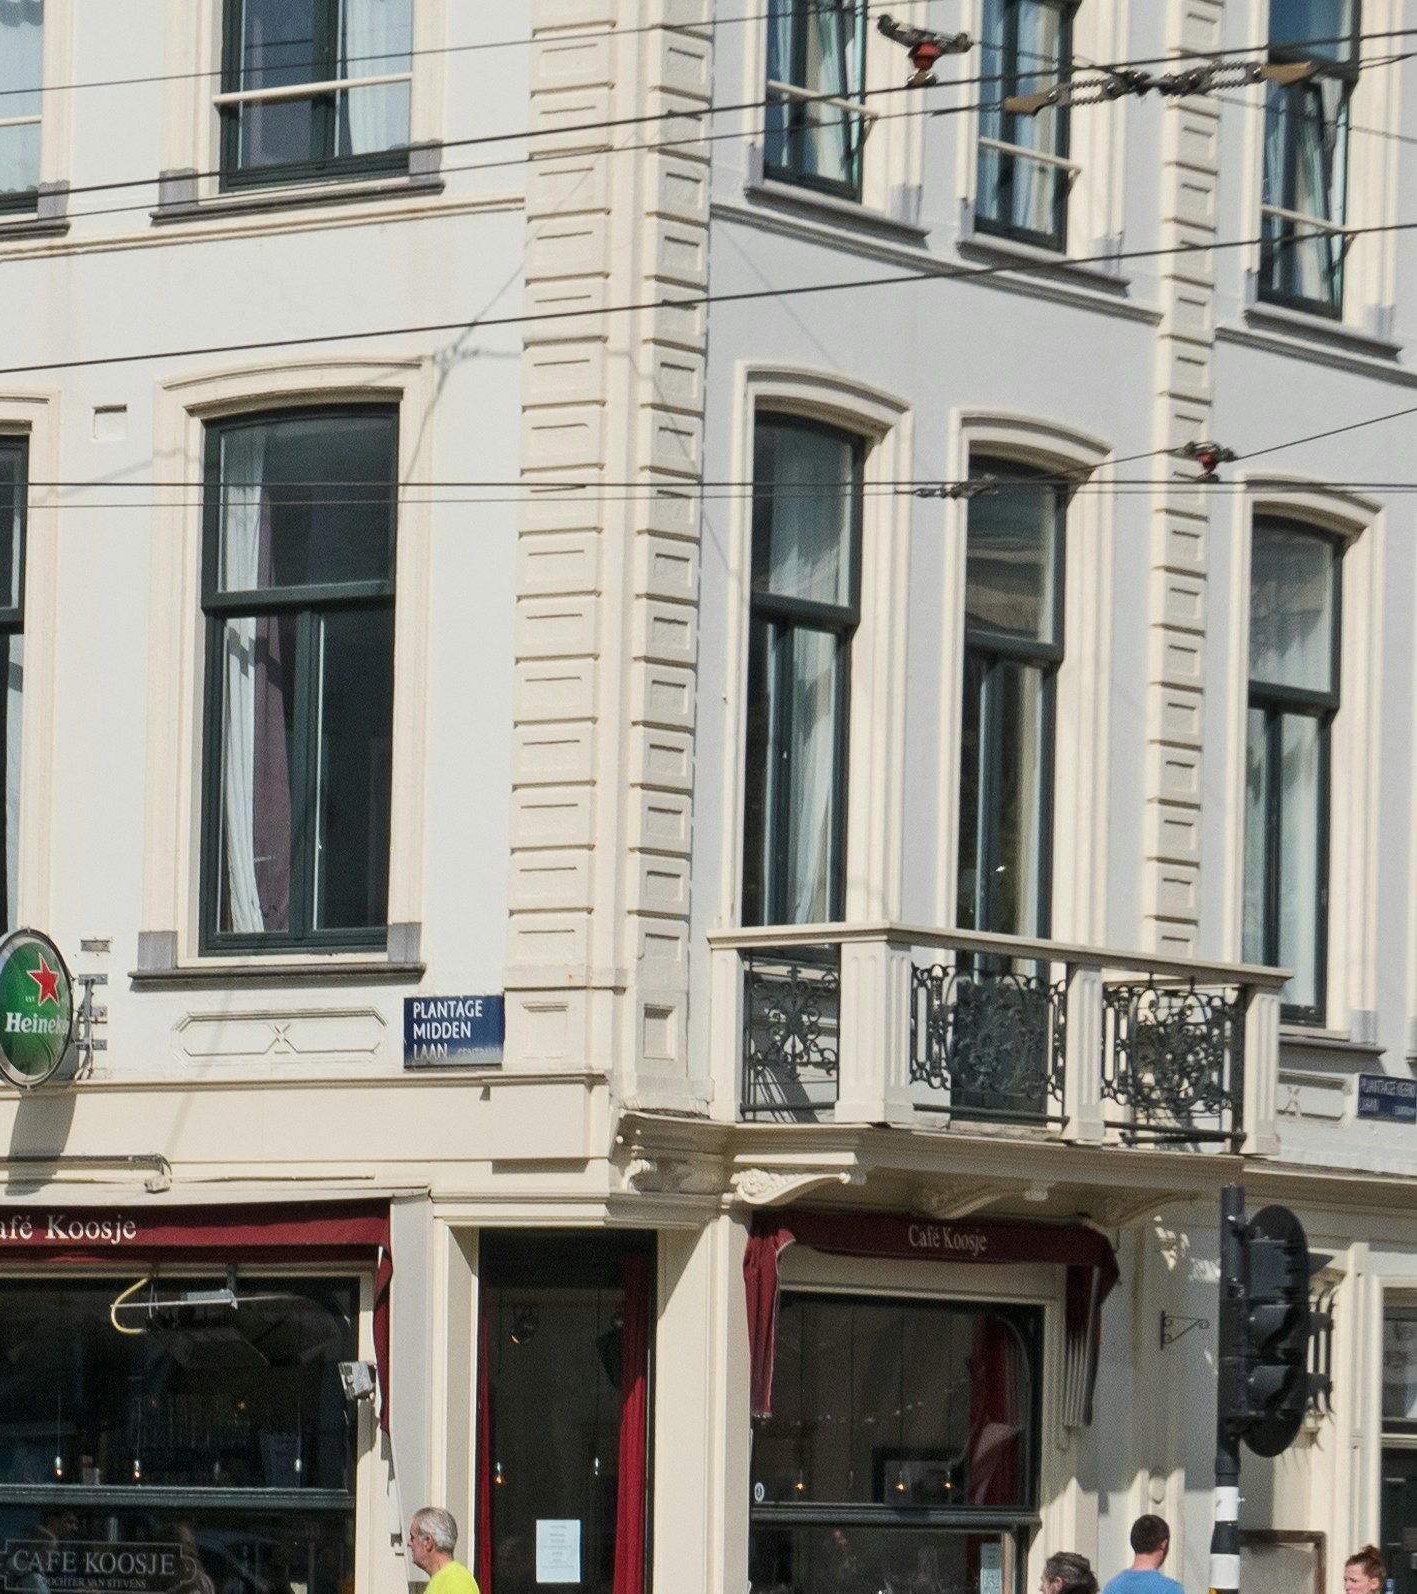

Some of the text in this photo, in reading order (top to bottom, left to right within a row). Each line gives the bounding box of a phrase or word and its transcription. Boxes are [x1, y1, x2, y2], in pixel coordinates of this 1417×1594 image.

[413, 1000, 483, 1019] PLANTAGE
[413, 1021, 471, 1040] MIDDEN
[413, 1042, 448, 1061] LAAN
[44, 1213, 137, 1245] Koosje
[908, 1224, 987, 1257] Café Koosje
[85, 1551, 175, 1575] KOOSJE
[107, 1578, 147, 1589] STEVENS
